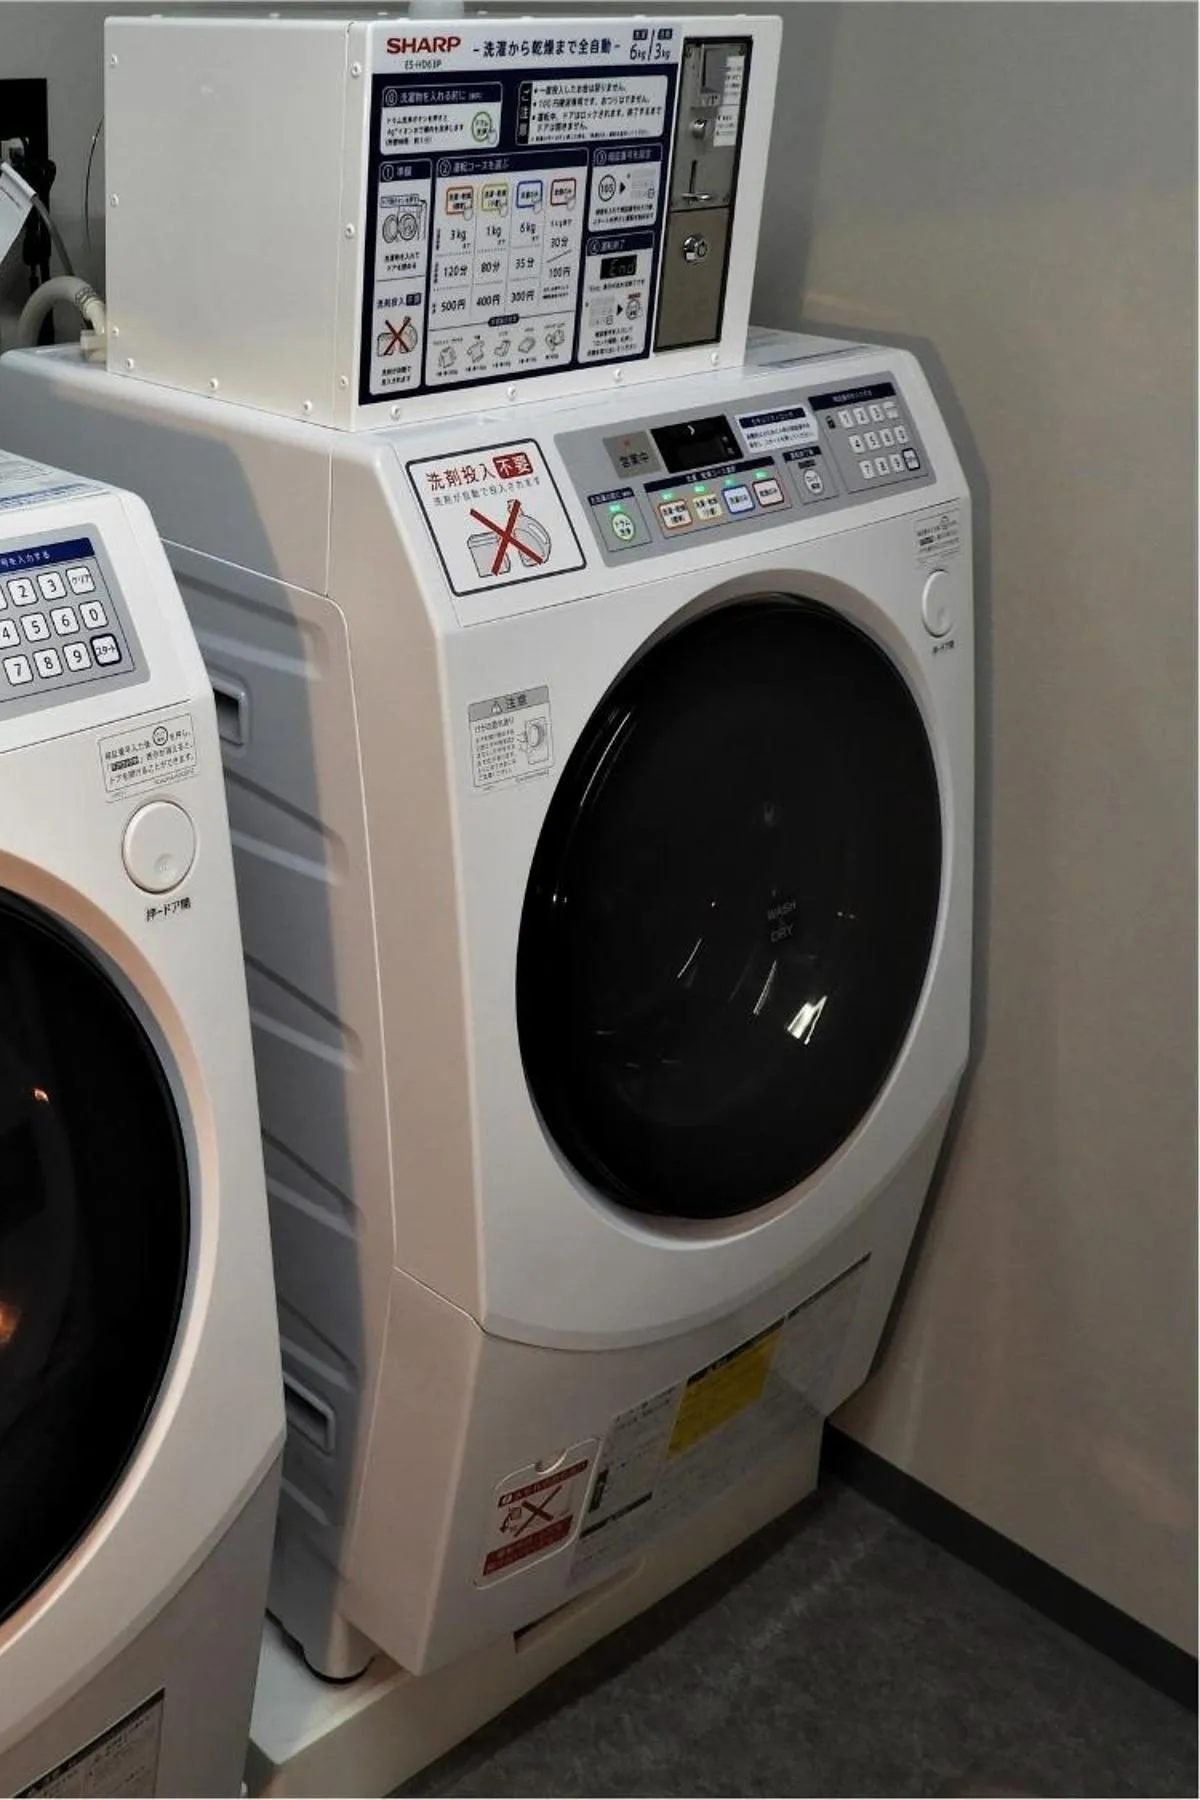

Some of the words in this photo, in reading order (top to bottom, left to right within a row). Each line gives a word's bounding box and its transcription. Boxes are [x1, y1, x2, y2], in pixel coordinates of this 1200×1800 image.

[386, 36, 461, 54] SHARP
[426, 463, 496, 491] 洗剤投入
[495, 454, 532, 476] 不要
[19, 584, 29, 599] 2
[47, 578, 57, 593] 3
[61, 614, 70, 629] 6
[89, 608, 99, 623] 0
[2, 626, 11, 641] 4
[31, 619, 41, 634] 5
[43, 656, 54, 671] 8
[72, 649, 82, 665] 9
[13, 663, 23, 678] 7
